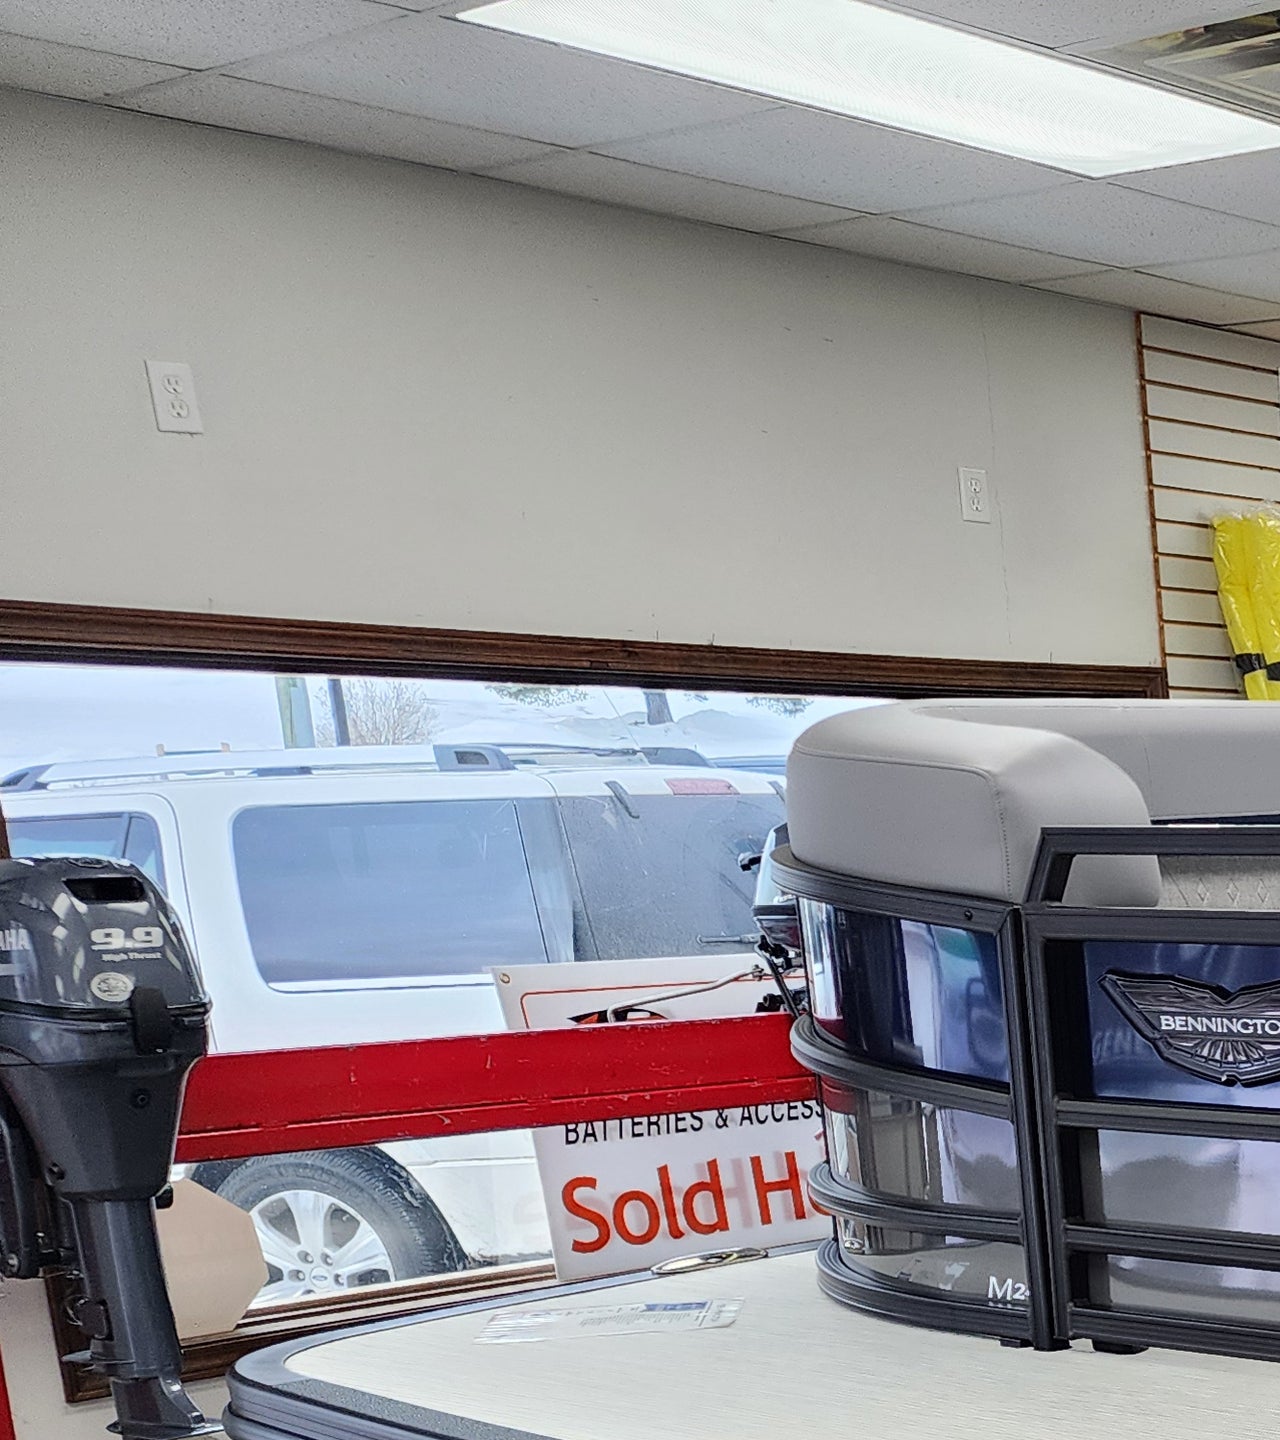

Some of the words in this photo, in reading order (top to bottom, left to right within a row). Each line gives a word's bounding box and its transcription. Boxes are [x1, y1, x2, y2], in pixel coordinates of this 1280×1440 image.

[90, 926, 164, 950] 9.9
[564, 1111, 703, 1146] BATTERIES
[715, 1107, 730, 1129] &
[561, 1157, 730, 1254] Sold
[750, 1151, 831, 1226] H
